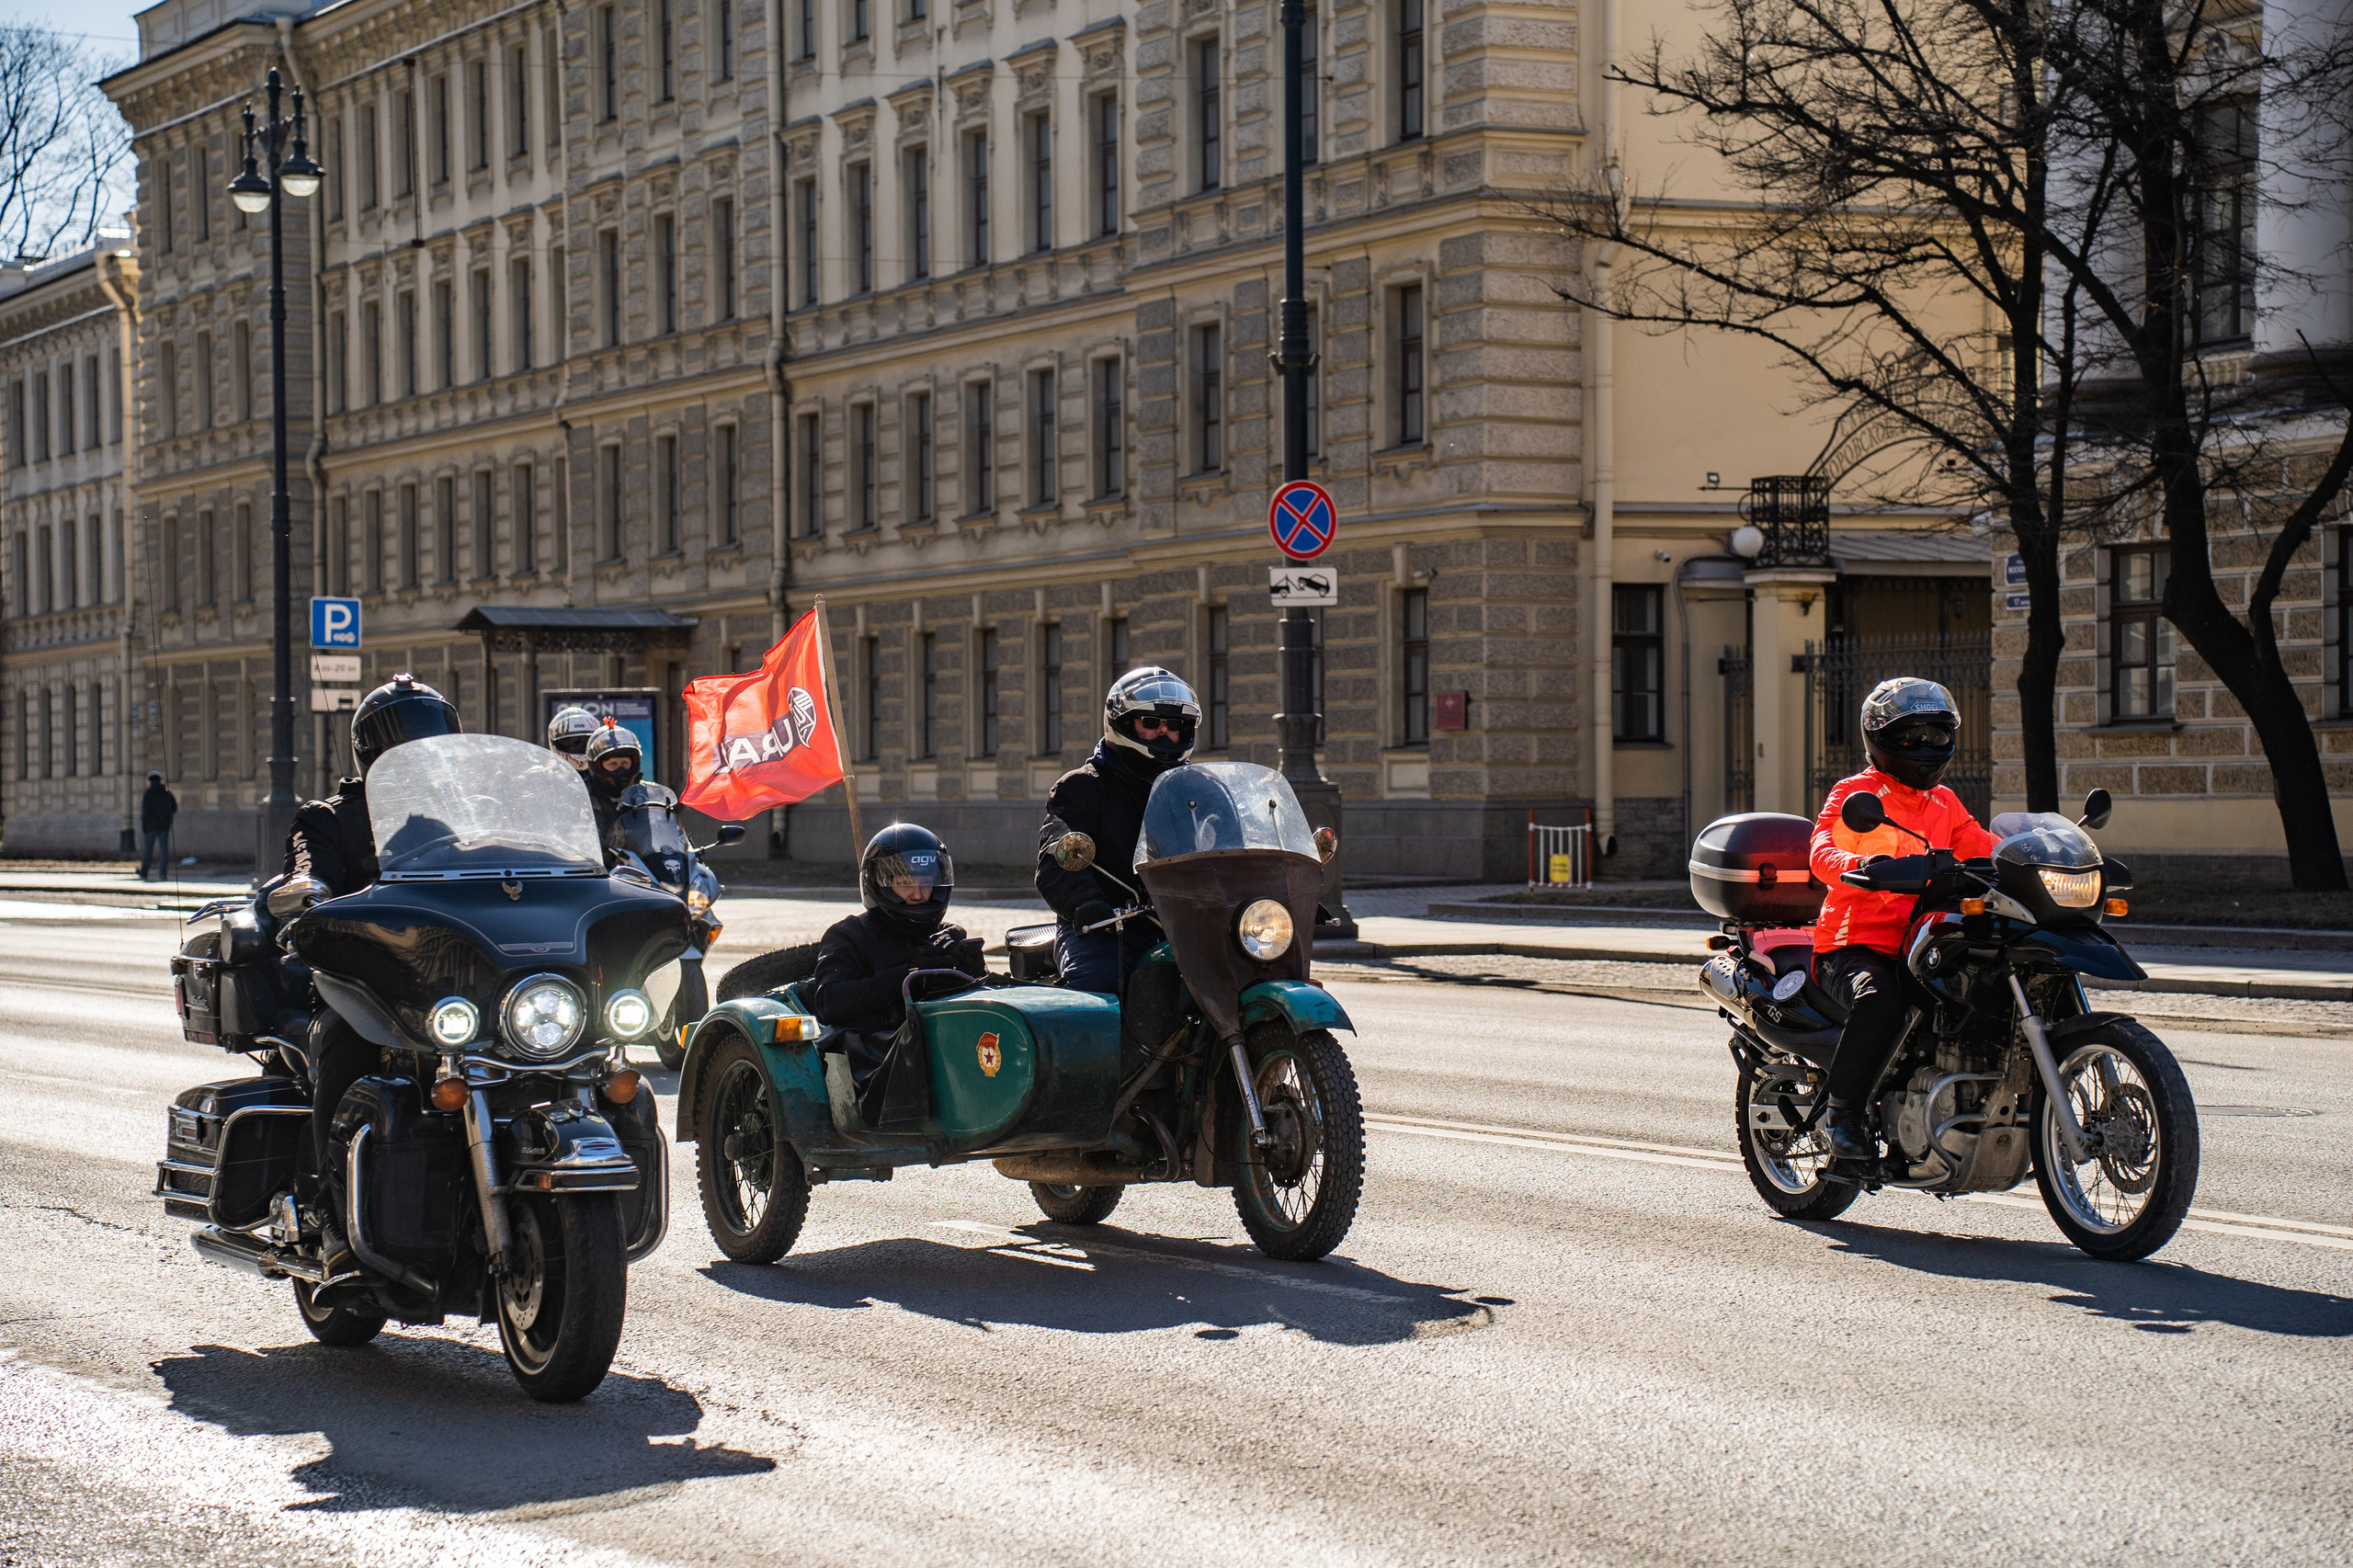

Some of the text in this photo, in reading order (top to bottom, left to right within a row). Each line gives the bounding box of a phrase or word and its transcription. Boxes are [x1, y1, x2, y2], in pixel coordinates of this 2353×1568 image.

[324, 603, 352, 643] P
[557, 702, 614, 715] ON
[911, 856, 937, 866] agv
[1768, 1005, 1783, 1023] GS
